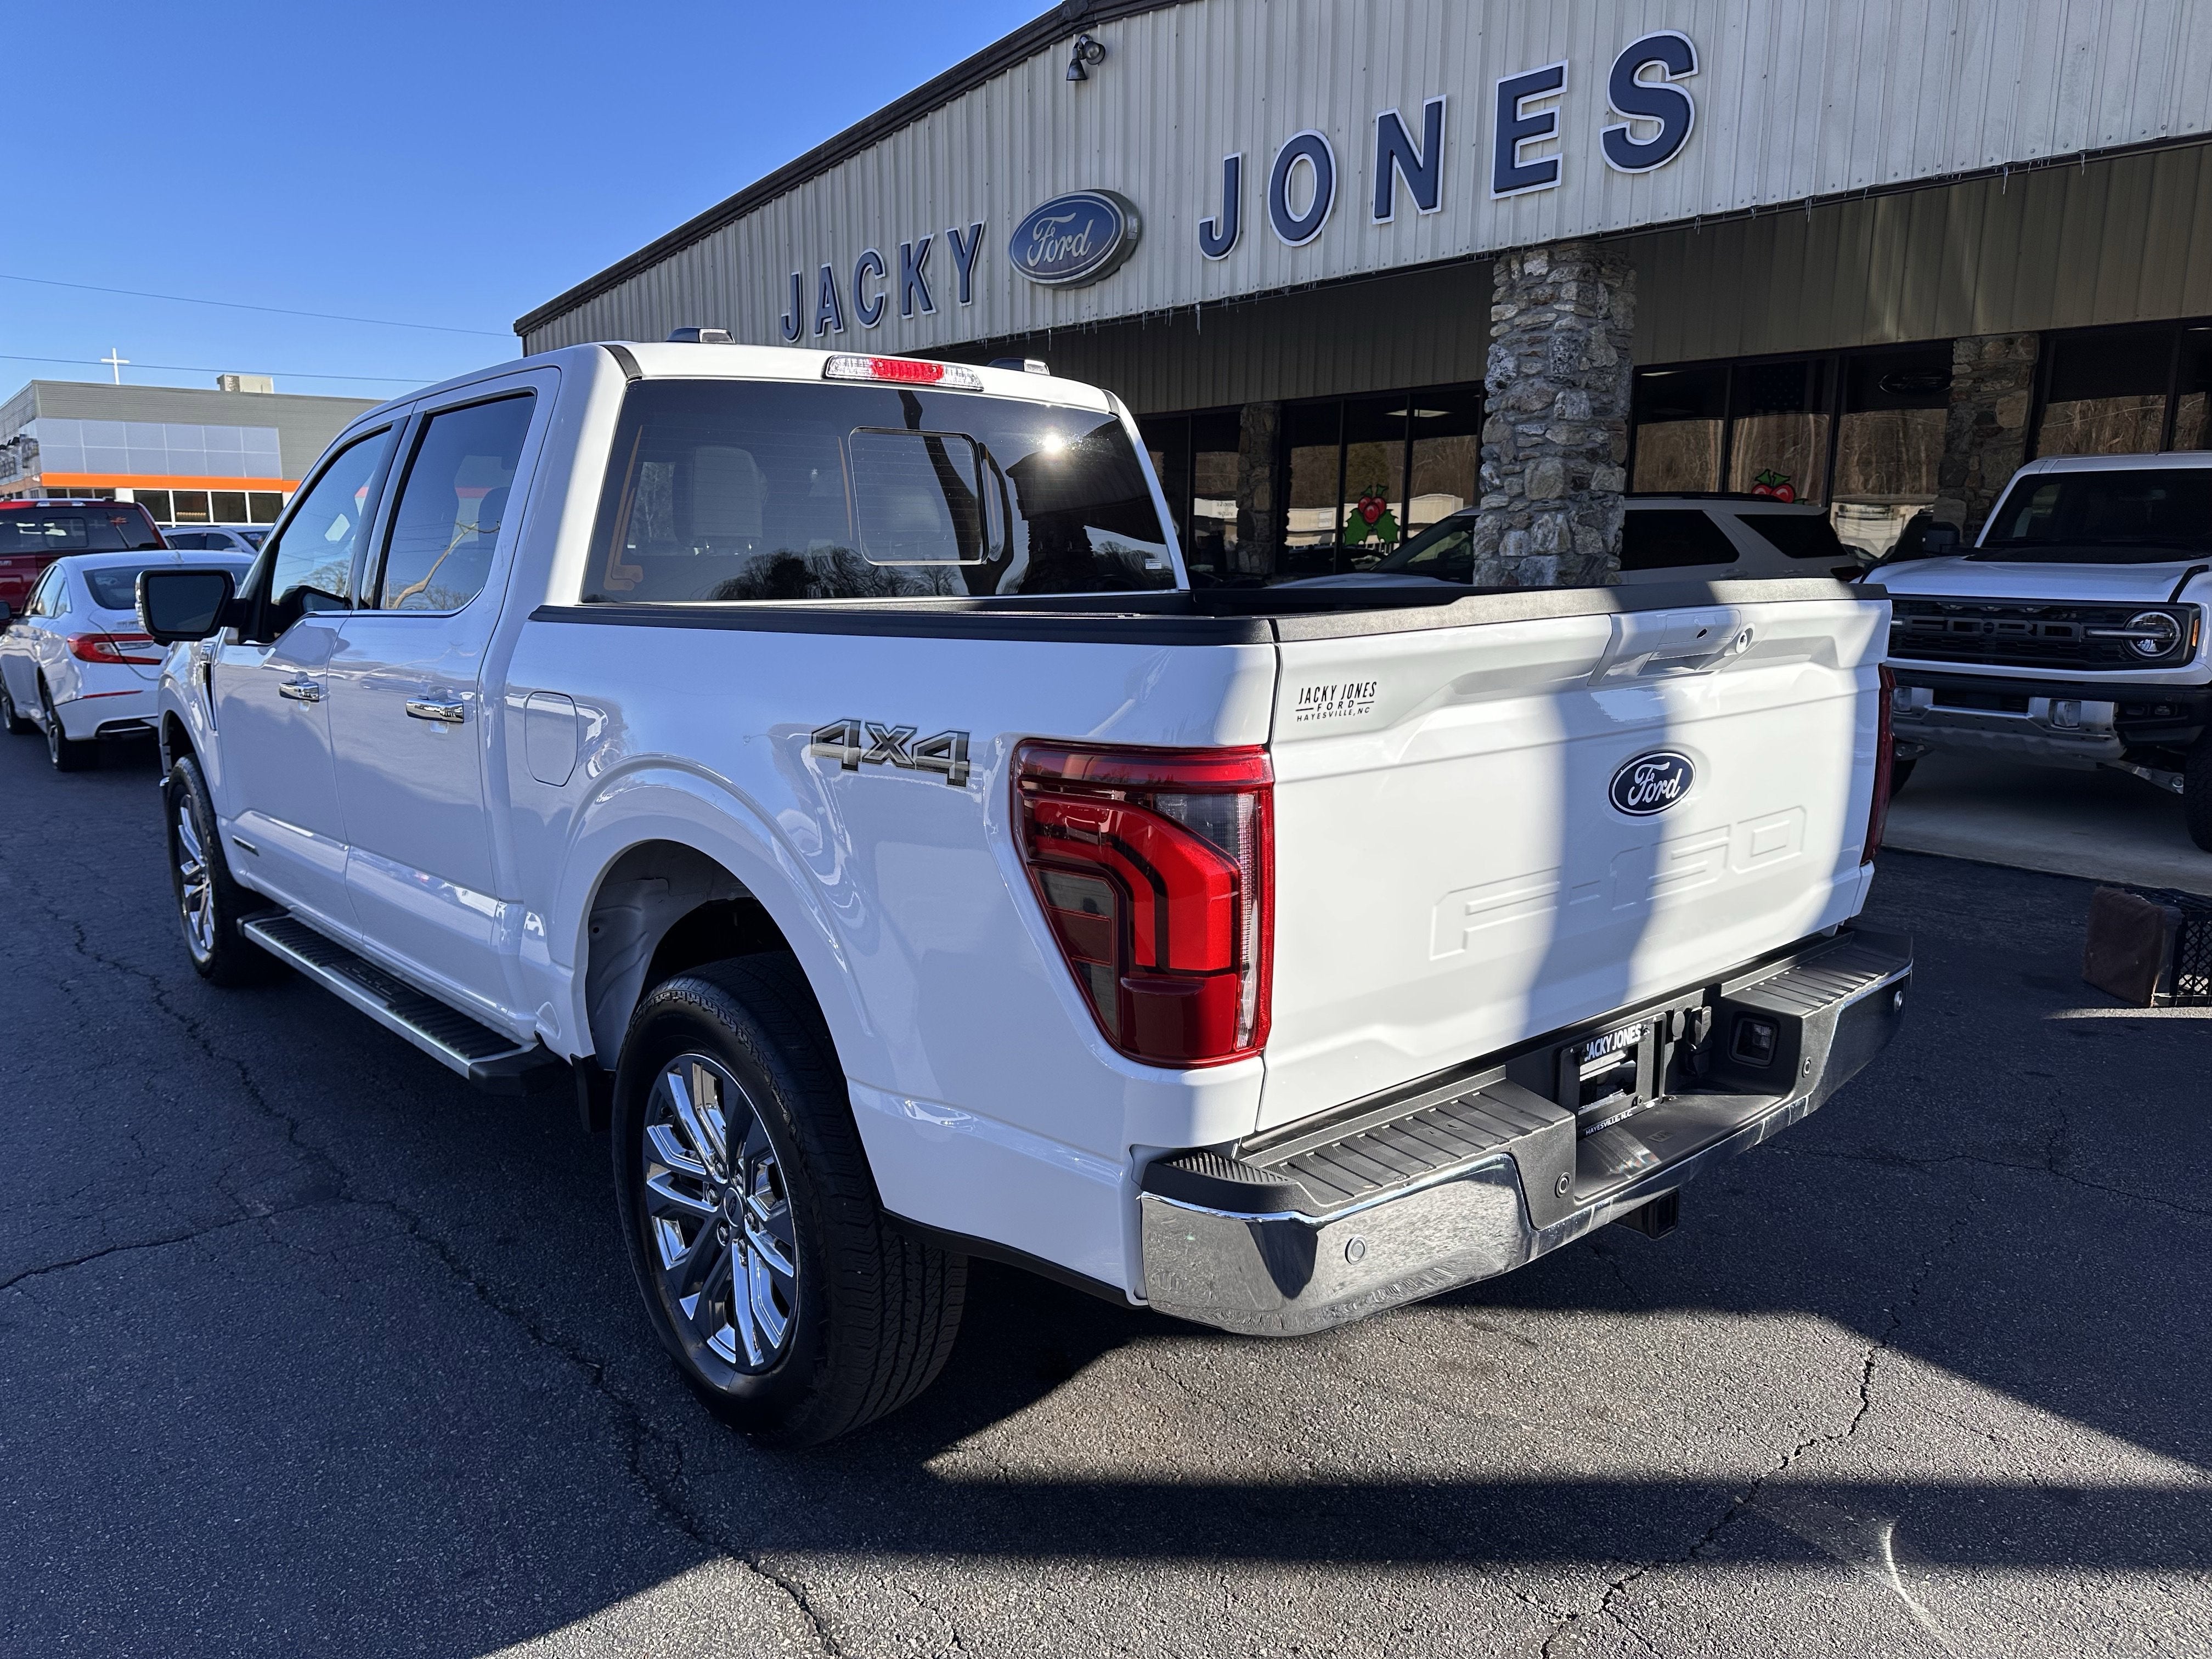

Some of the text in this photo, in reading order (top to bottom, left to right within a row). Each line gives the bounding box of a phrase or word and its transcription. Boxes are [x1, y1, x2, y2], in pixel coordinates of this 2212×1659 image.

[1199, 30, 1699, 261] JONES
[1026, 212, 1094, 267] Ford
[781, 221, 985, 343] JACKY
[1298, 681, 1377, 704] JACKY JONES
[1317, 700, 1354, 712] FORD
[1296, 709, 1356, 722] HAYESVILLE,
[1627, 761, 1683, 806] Ford
[1430, 805, 1807, 961] F-150
[1584, 1023, 1641, 1062] JACKY JONES
